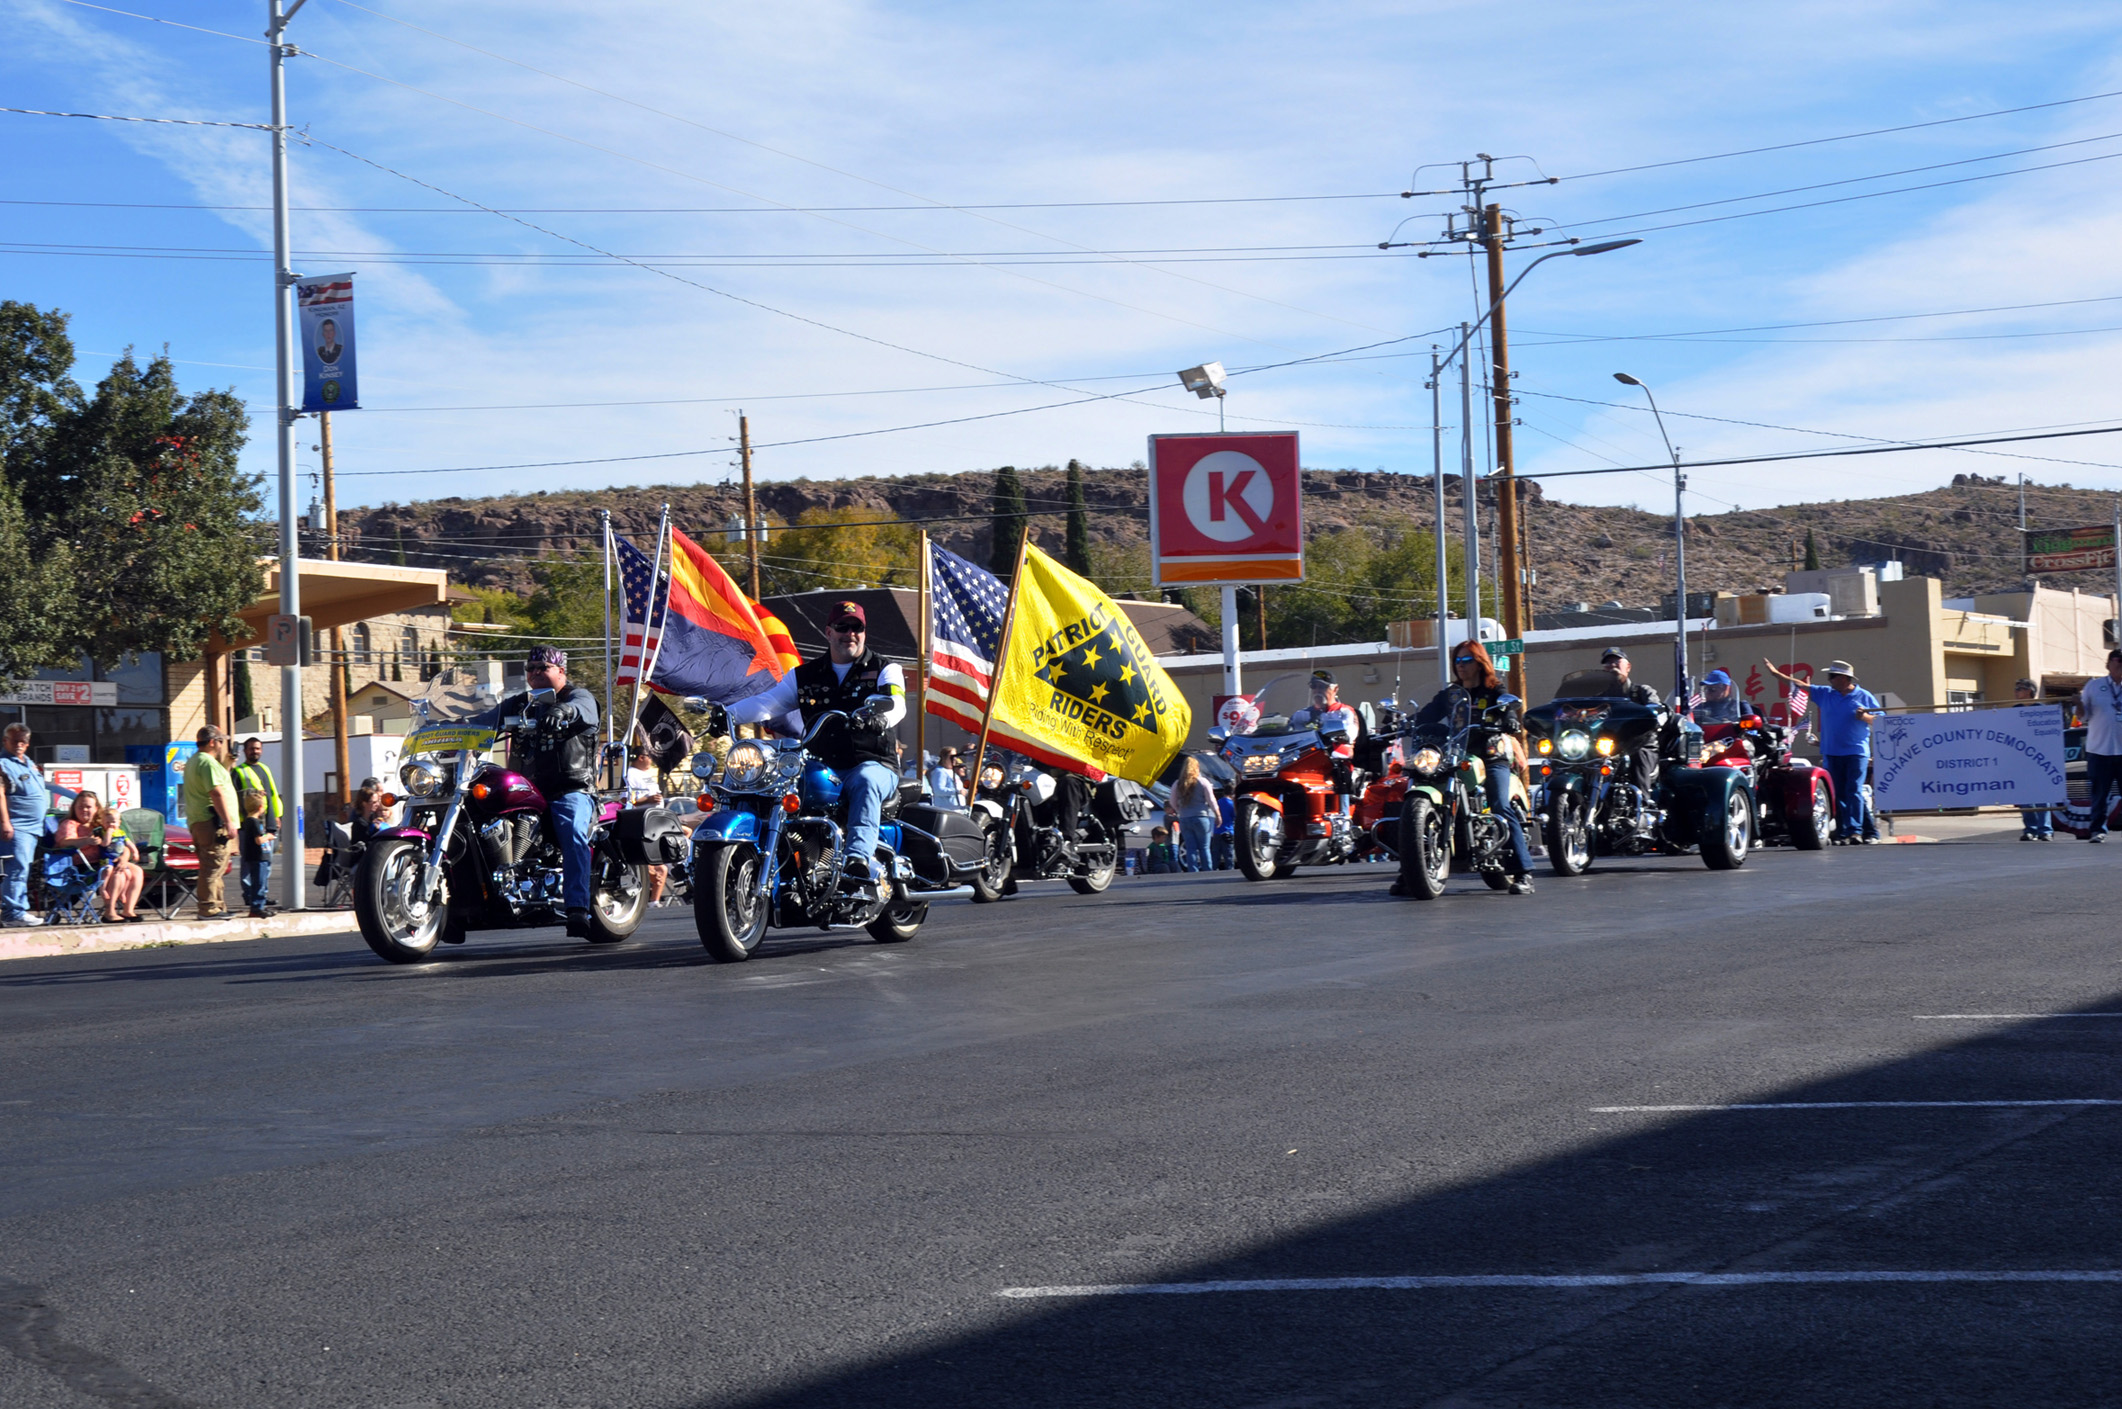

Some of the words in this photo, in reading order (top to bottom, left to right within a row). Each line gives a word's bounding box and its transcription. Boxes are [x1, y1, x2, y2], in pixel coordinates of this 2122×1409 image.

[1208, 470, 1266, 535] K
[1032, 602, 1107, 667] PATRIOT
[1492, 643, 1506, 653] 3rd
[1511, 641, 1521, 652] St
[27, 683, 52, 692] ATCH
[1125, 625, 1167, 715] GUARD
[1050, 691, 1128, 740] RIDERS
[1060, 716, 1083, 739] With
[1877, 743, 1921, 794] MOHAVE
[1923, 729, 1984, 749] COUNTY
[1986, 730, 2064, 785] DEMOCRATS
[1936, 757, 1989, 769] DISTRICT
[1993, 757, 1998, 767] 1
[1921, 780, 2015, 795] Kingman
